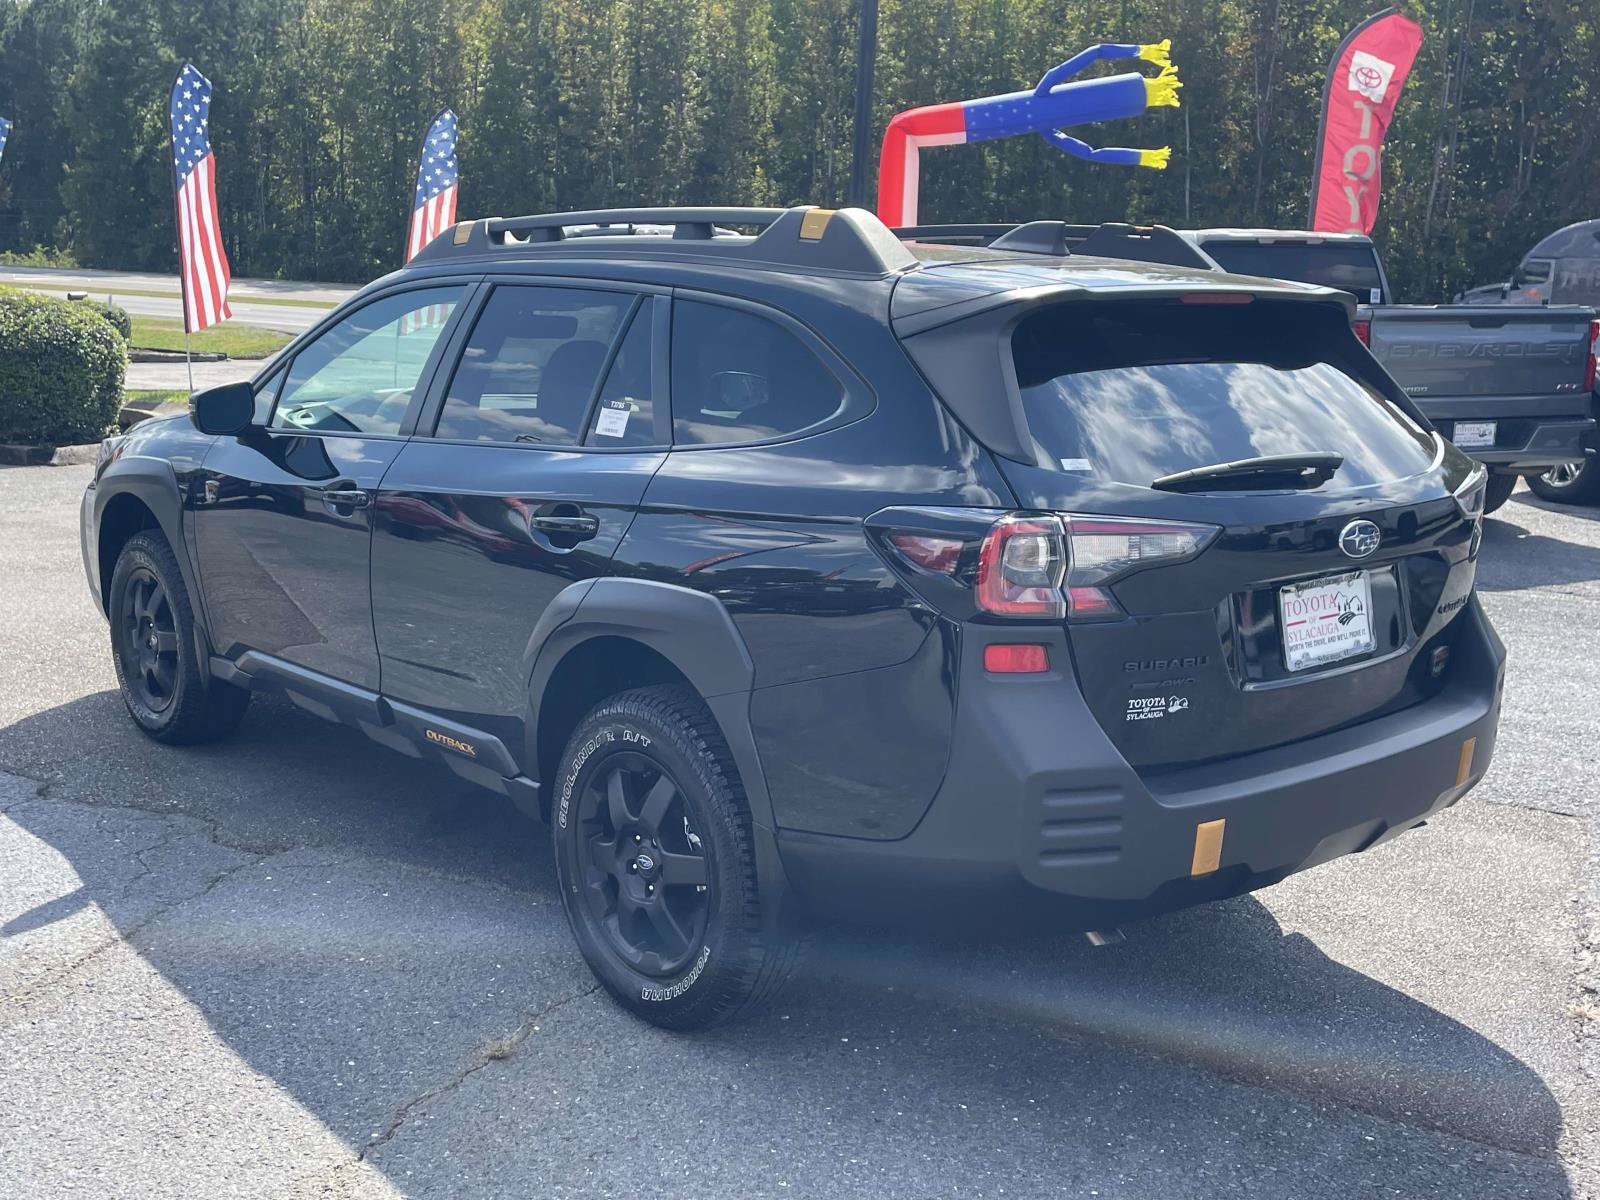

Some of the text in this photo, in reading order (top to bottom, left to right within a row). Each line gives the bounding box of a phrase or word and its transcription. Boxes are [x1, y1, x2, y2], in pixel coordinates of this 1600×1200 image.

[1342, 100, 1376, 235] TOY
[1389, 343, 1579, 357] CHEVROLET
[1285, 593, 1337, 617] TOYOTA
[1288, 622, 1340, 642] SYLACAUGA
[1289, 642, 1305, 652] WORTH
[1305, 640, 1313, 648] THE
[1327, 635, 1337, 643] AND
[1123, 656, 1209, 672] SUBARU
[1160, 677, 1196, 687] AWD
[1128, 697, 1166, 709] TOYOTA
[1126, 711, 1164, 721] SYLACAUGA
[426, 729, 476, 756] OUTBACK
[623, 730, 652, 747] A/T
[641, 945, 711, 1002] YOKOHAMA
